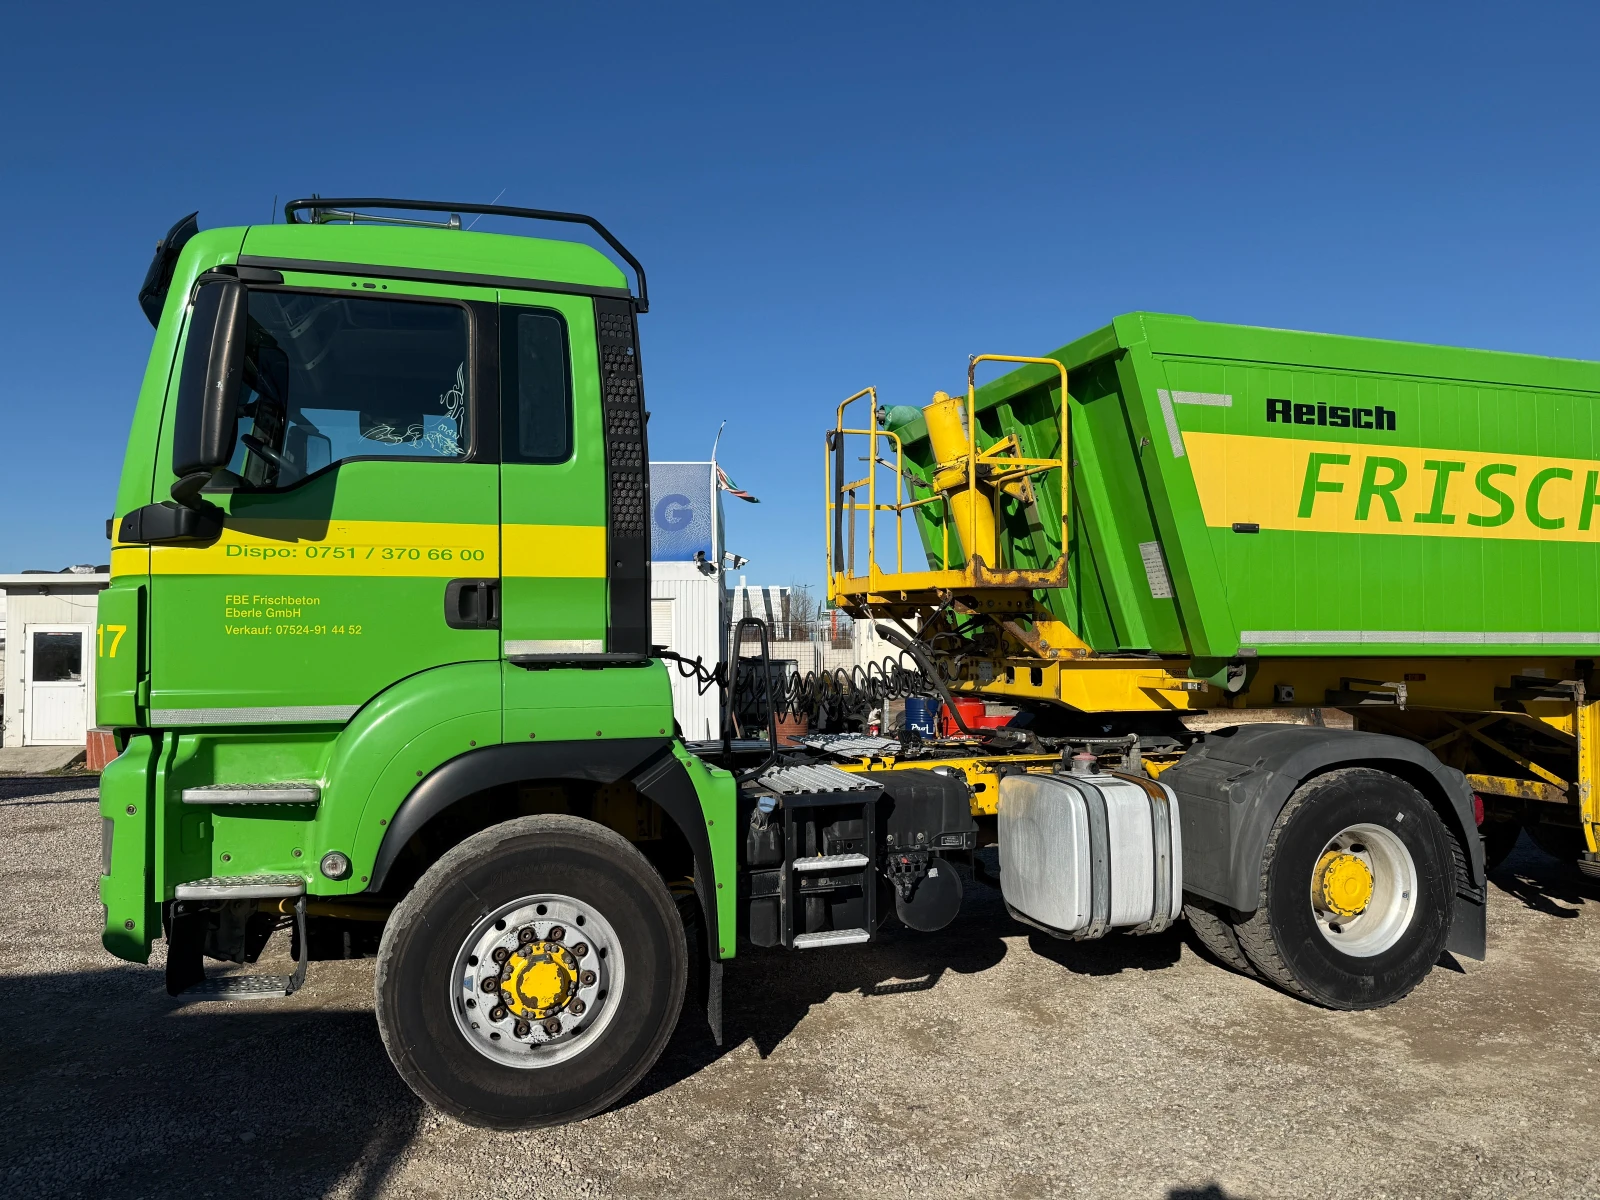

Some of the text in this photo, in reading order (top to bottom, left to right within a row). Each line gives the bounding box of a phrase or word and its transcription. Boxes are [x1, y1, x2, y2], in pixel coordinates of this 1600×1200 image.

[1266, 398, 1396, 431] Reisch
[225, 544, 485, 561] Dispo: 0751 / 370 66 00
[225, 594, 320, 605] FBE Frischbeton
[225, 607, 301, 618] Eberle GmbH
[225, 625, 362, 635] Verkauf: 07524-91 44 52
[97, 624, 127, 658] 17
